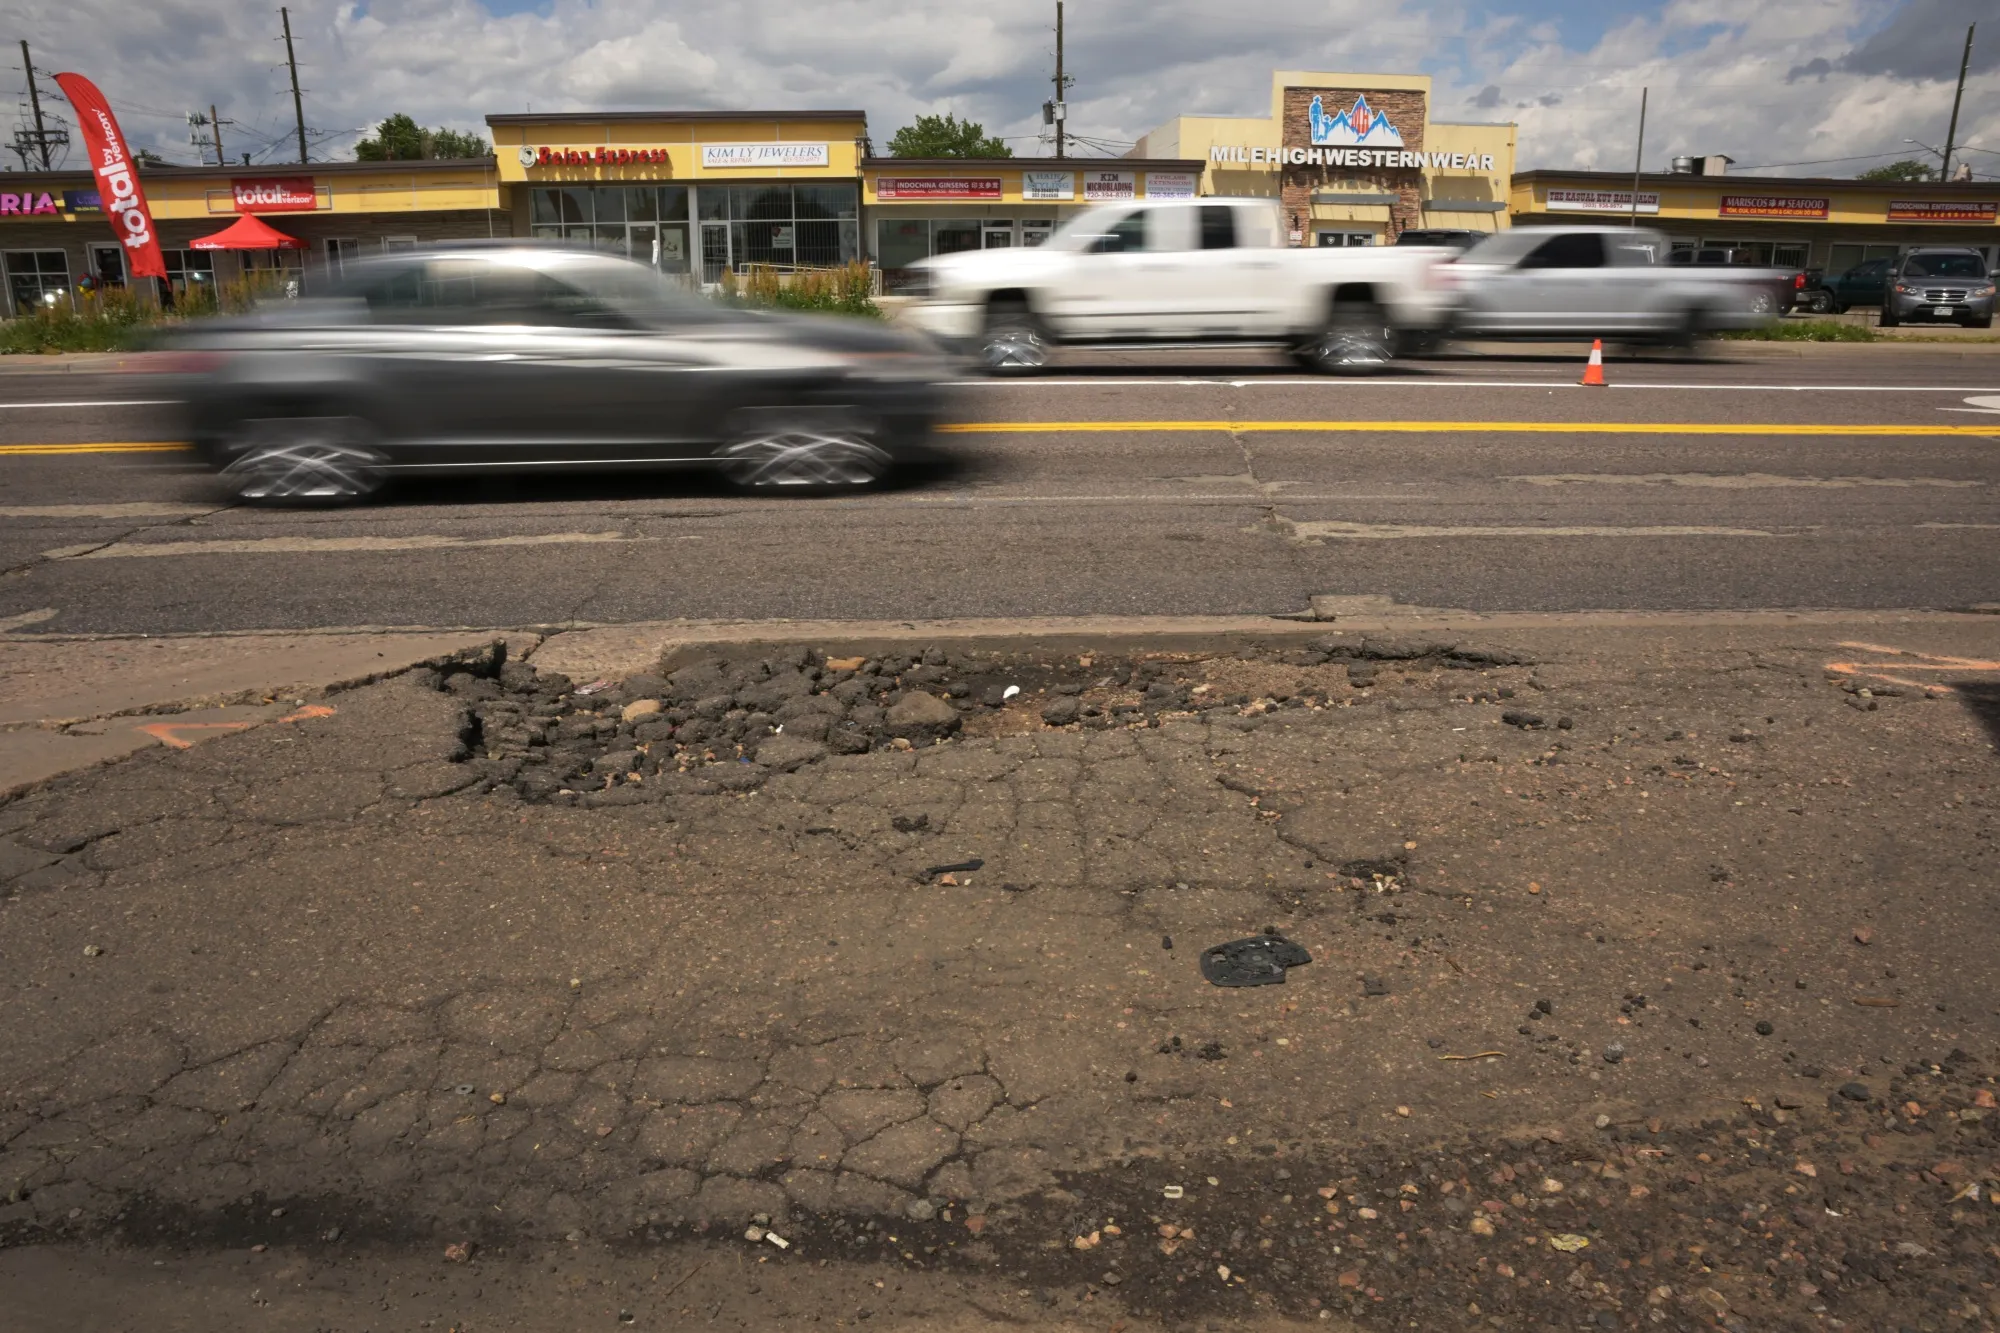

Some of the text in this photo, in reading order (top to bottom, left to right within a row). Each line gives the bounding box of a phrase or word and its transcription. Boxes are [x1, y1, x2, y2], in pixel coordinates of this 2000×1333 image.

[102, 148, 114, 166] by
[538, 146, 668, 167] Relax Express
[707, 146, 824, 159] KIM LY JEWELERS
[1100, 173, 1118, 181] KIM
[897, 181, 937, 189] INDOCHINA
[938, 181, 969, 189] GINSENG
[1086, 182, 1133, 191] MICROBLADING
[235, 185, 282, 205] total
[282, 189, 291, 197] by
[1549, 191, 1564, 201] THE
[1565, 192, 1596, 202] KASUAL
[1596, 193, 1612, 203] KUT
[1613, 193, 1632, 203] HAIR
[0, 192, 58, 216] RIA
[99, 162, 150, 248] total
[282, 196, 310, 204] verizon
[1726, 197, 1768, 208] MARISCOS
[1787, 199, 1824, 209] SEAFOOD
[1891, 202, 1996, 212] INDOCHINA ENTERPRISES, INC.
